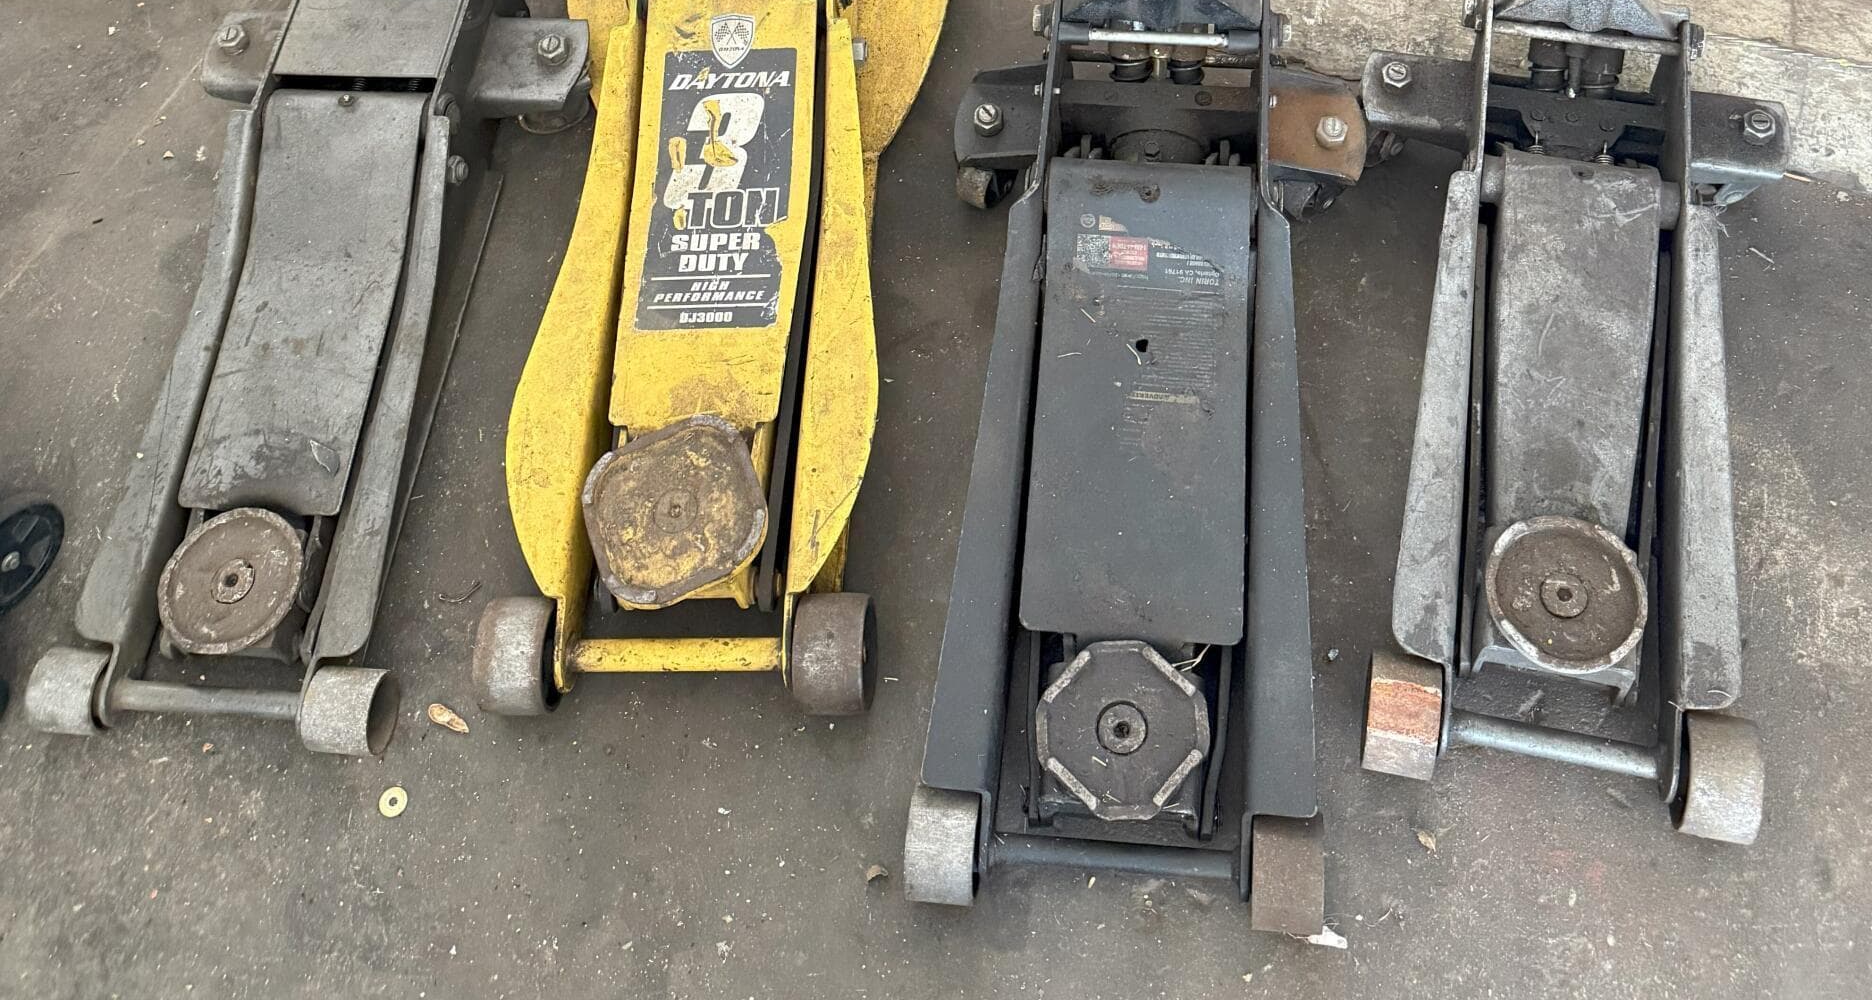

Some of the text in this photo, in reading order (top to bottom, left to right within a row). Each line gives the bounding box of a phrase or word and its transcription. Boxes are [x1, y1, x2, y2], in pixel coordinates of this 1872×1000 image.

[668, 70, 788, 90] DAYTONA
[663, 93, 765, 210] 3
[686, 187, 780, 230] TON
[671, 232, 760, 252] SUPER
[678, 253, 749, 272] DUTY
[690, 281, 731, 292] HIGH
[1195, 278, 1220, 286] TORIN
[653, 290, 765, 303] PERFORMANCE
